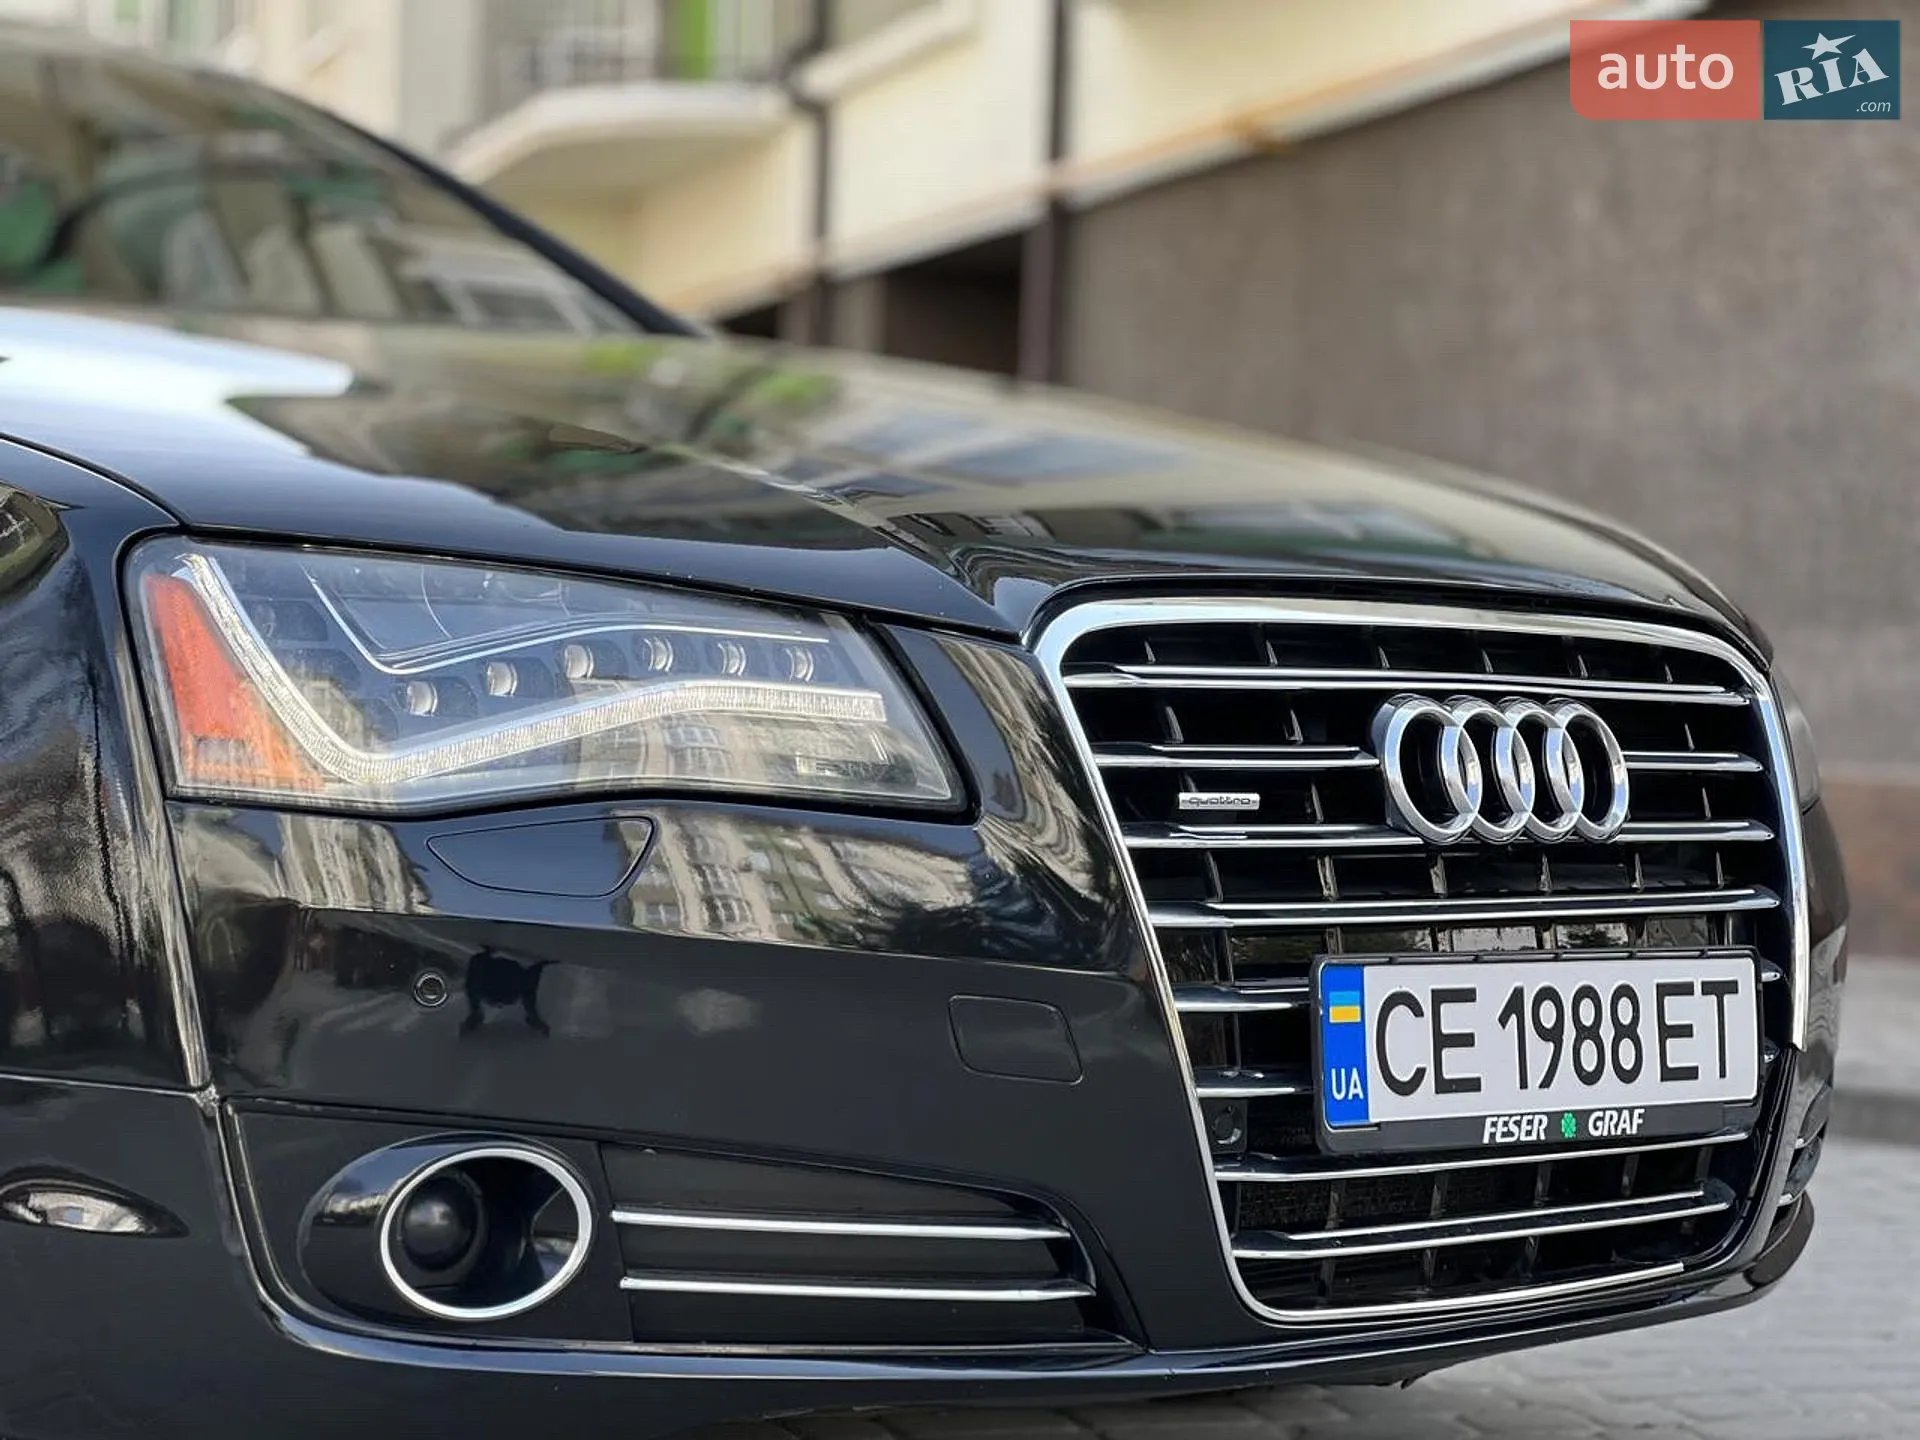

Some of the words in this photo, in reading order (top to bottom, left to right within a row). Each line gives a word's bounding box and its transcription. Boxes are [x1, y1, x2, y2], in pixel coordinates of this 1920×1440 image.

[1188, 796, 1251, 807] quattro
[1376, 987, 1482, 1096] CE
[1497, 983, 1644, 1090] 1988
[1655, 979, 1739, 1082] ET
[1332, 1067, 1364, 1100] UA
[1483, 1114, 1547, 1144] FESER
[1588, 1109, 1645, 1137] GRAF
